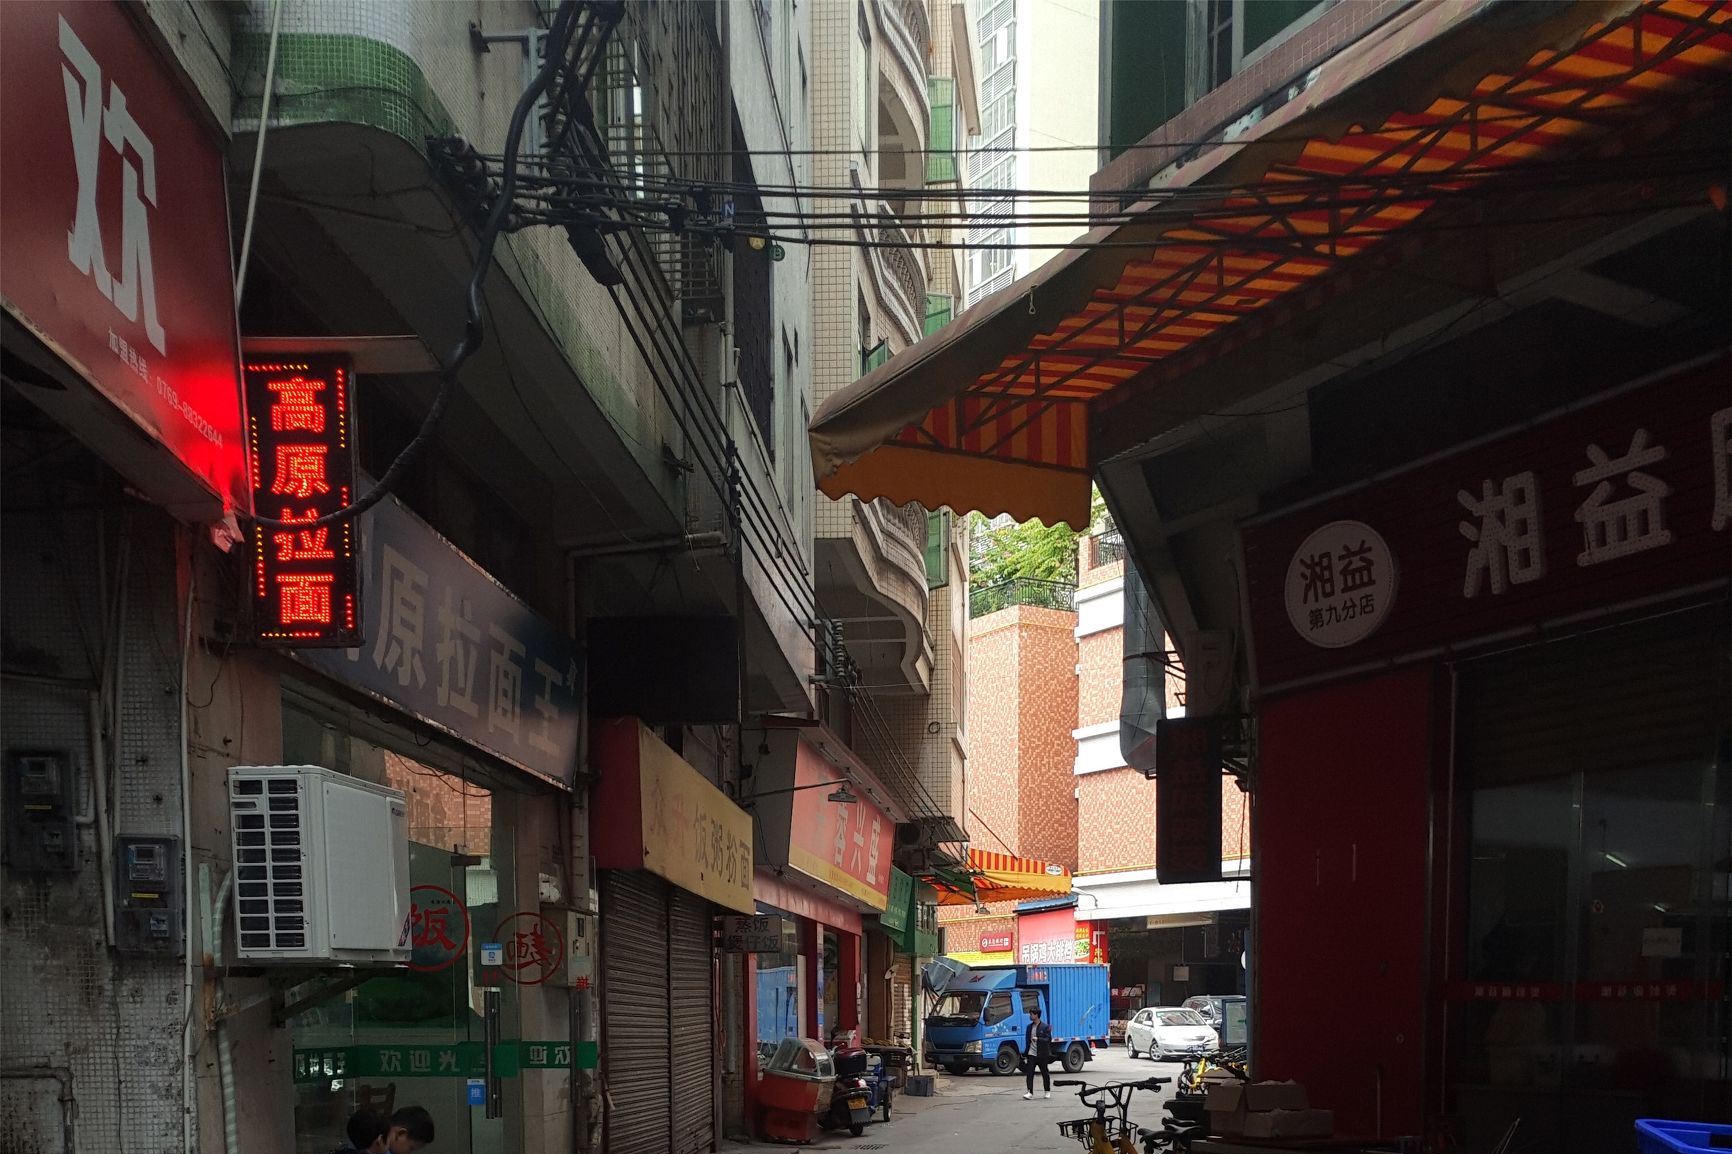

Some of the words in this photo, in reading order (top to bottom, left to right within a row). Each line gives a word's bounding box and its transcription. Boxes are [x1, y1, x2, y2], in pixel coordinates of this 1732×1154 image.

[58, 13, 166, 356] 欢
[267, 377, 334, 624] 高原拉面
[1299, 539, 1377, 604] 湘益
[1308, 593, 1375, 632] 第九分店
[346, 543, 563, 755] 原拉面王
[728, 935, 778, 951] 煲仔饭
[735, 917, 769, 933] 蒸饭
